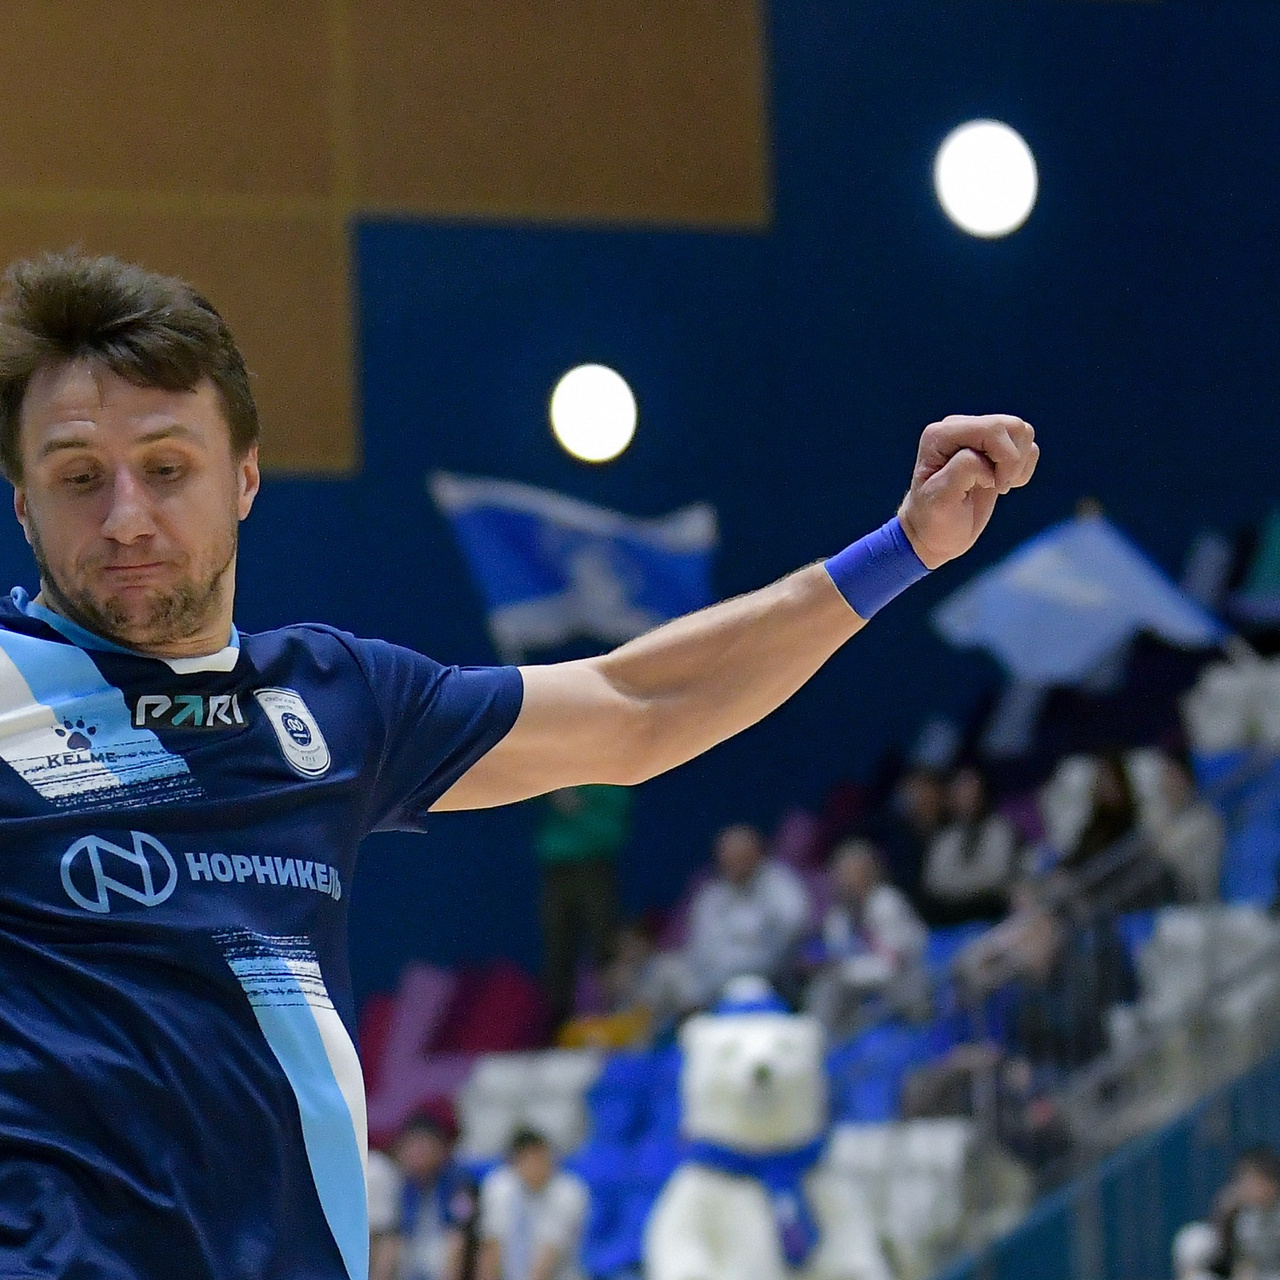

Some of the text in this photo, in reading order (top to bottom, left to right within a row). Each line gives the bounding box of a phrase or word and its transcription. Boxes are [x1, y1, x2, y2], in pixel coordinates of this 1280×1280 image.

[135, 694, 245, 727] PARI
[46, 751, 118, 769] KELME
[184, 852, 342, 901] НОРНИКЕЛЬ
